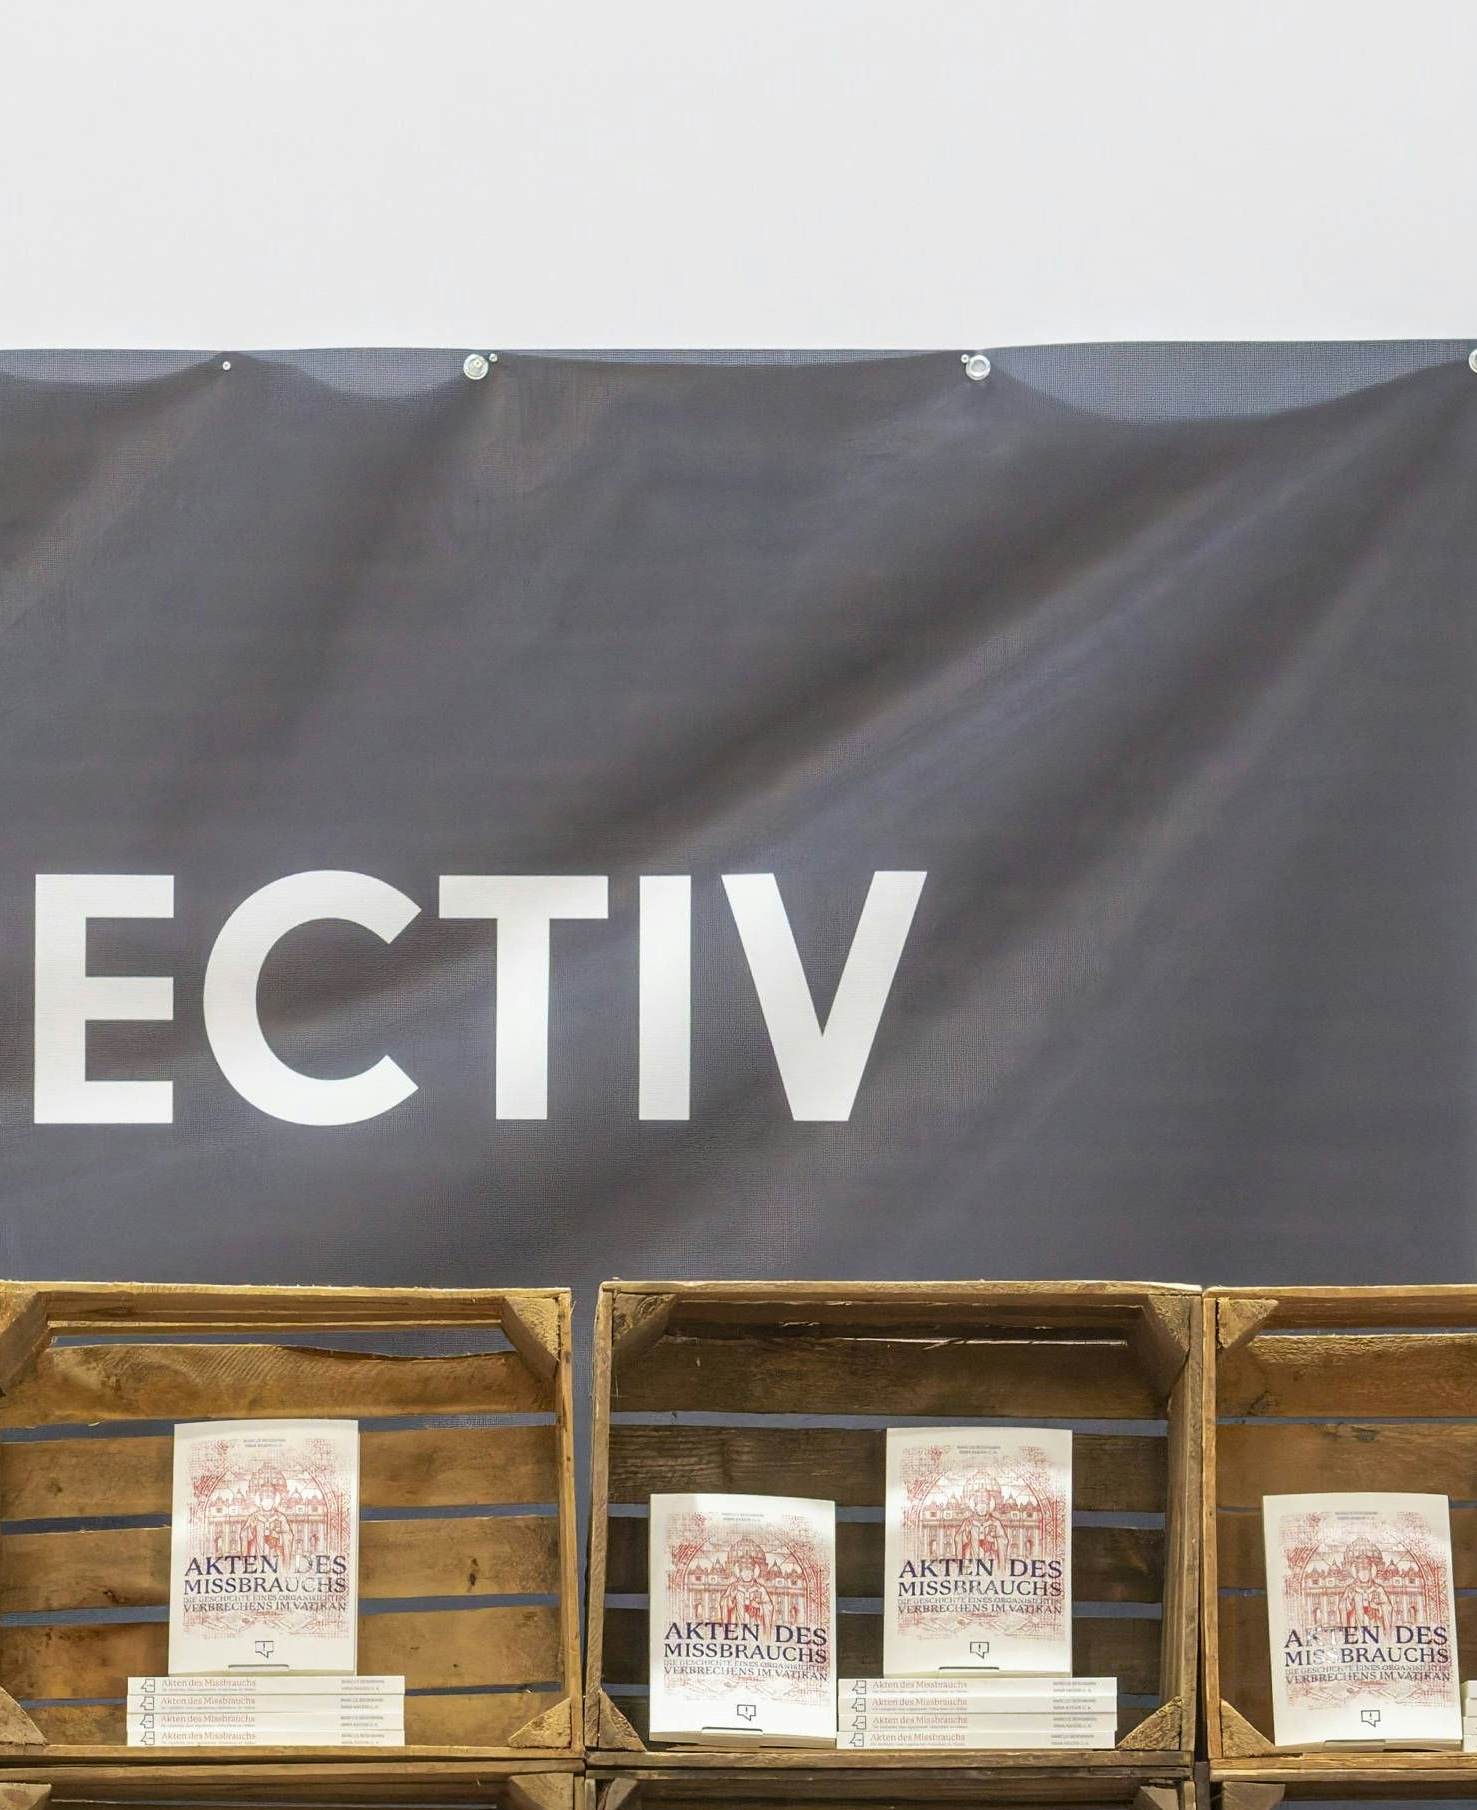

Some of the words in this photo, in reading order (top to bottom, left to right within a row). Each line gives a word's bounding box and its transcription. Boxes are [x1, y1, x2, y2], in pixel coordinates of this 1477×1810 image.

[184, 1555, 279, 1575] AKTEN
[295, 1555, 347, 1574] DES
[898, 1558, 995, 1578] AKTEN
[1009, 1559, 1062, 1578] DES
[184, 1577, 346, 1595] MISSBRAUCHS
[898, 1581, 1062, 1596] MISSBRAUCHS
[665, 1622, 760, 1641] AKTEN
[775, 1625, 827, 1646] DES
[1285, 1627, 1380, 1648] AKTEN
[1396, 1626, 1447, 1645] DES
[664, 1643, 827, 1664] MISSBRAUCHS
[1285, 1648, 1449, 1666] MISSBRAUCHS
[664, 1667, 754, 1678] VERBRECHENS
[757, 1669, 772, 1678] IM
[775, 1669, 827, 1682] VATIKAN
